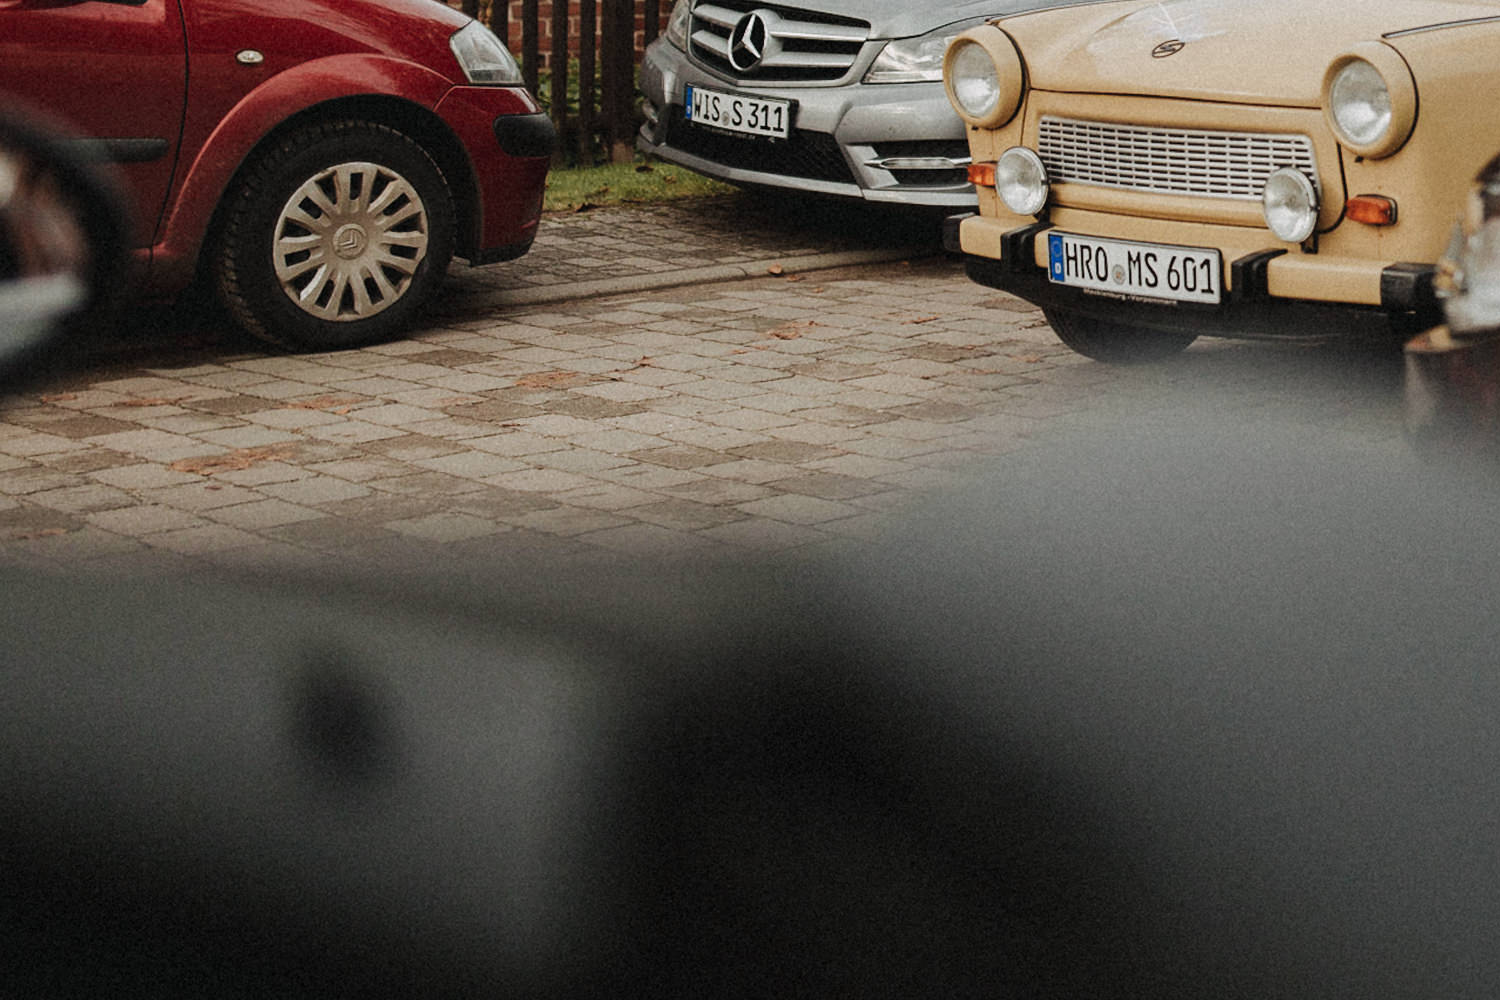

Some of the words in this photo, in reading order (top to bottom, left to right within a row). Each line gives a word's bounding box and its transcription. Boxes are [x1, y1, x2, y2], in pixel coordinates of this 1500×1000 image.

[694, 91, 720, 122] WIS
[732, 100, 743, 126] S
[747, 102, 785, 132] 311
[1065, 242, 1108, 282] HRO
[1128, 250, 1158, 288] MS
[1167, 256, 1214, 294] 601
